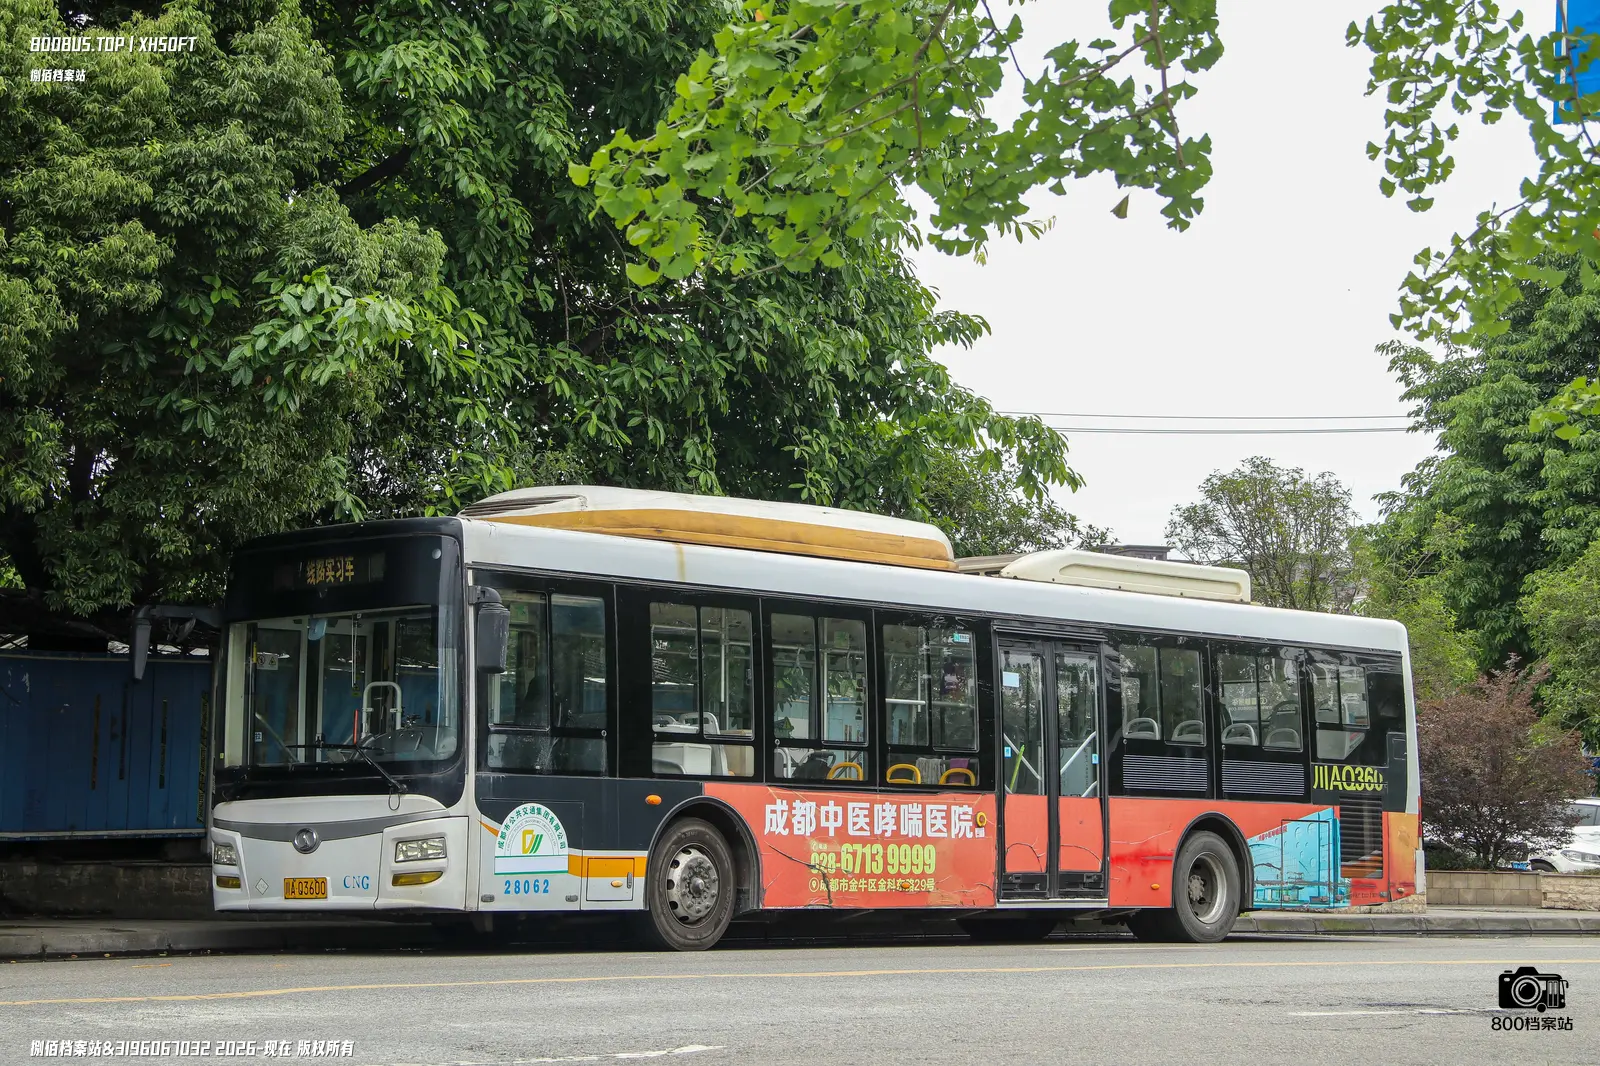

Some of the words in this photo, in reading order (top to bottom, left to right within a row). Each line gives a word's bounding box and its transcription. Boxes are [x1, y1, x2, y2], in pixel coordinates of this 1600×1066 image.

[306, 557, 354, 585] 线路实习车
[498, 806, 567, 849] 成都市公共交通集团有限公司
[764, 799, 974, 839] 成都中医哮喘医院
[811, 843, 883, 874] 028-6713
[887, 844, 936, 874] 9999
[343, 875, 370, 890] CNG
[504, 879, 549, 894] 28062
